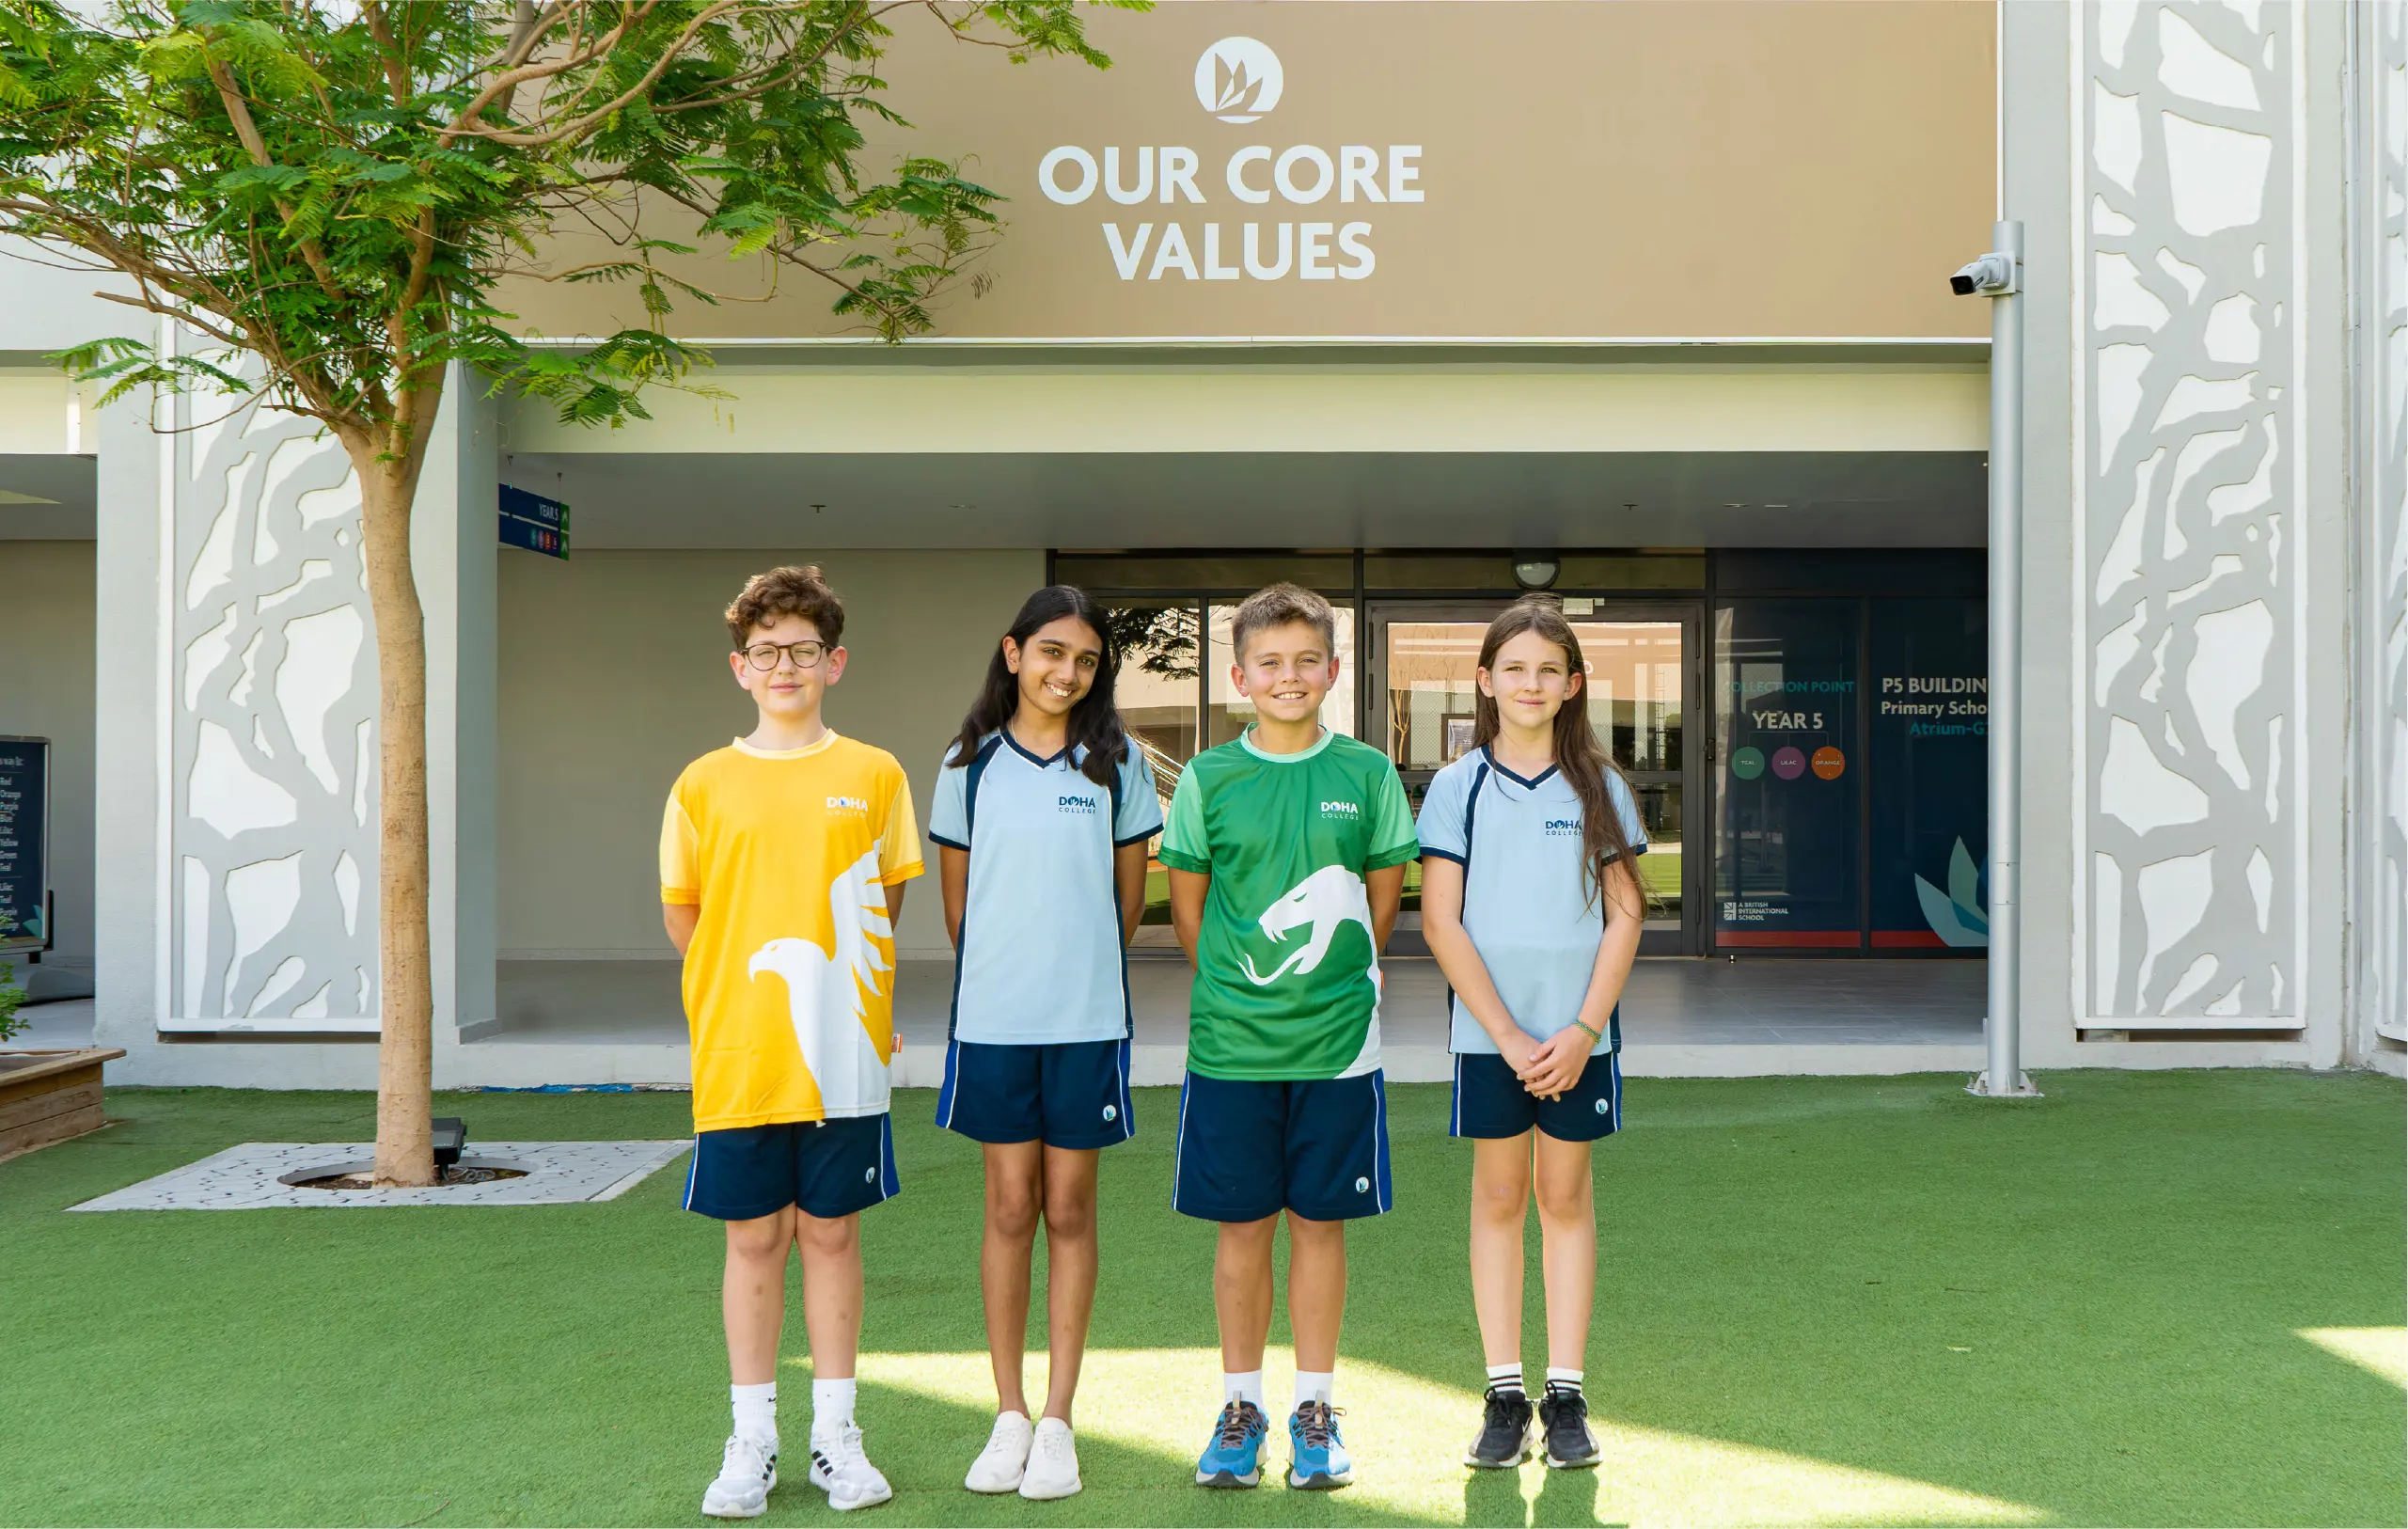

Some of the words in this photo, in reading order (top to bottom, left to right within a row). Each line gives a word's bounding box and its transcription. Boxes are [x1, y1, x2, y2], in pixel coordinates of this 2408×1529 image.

[1038, 145, 1207, 205] OUR
[1226, 144, 1424, 205] CORE
[1102, 221, 1376, 281] VALUES
[1723, 681, 1807, 694] OLLECTION
[1811, 681, 1855, 694] POINT
[1882, 677, 1903, 694] P5
[1909, 677, 1987, 694] BUILDIN
[1881, 701, 1944, 718] Primary
[1948, 700, 1988, 716] Scho
[1753, 713, 1808, 730] YEAR
[1813, 713, 1824, 730] 5
[1909, 720, 1986, 736] Atrium-G
[826, 796, 868, 812] DOHA
[1059, 796, 1096, 808] DOHA
[1321, 801, 1359, 814] DOHA
[1546, 820, 1582, 830] DOHA
